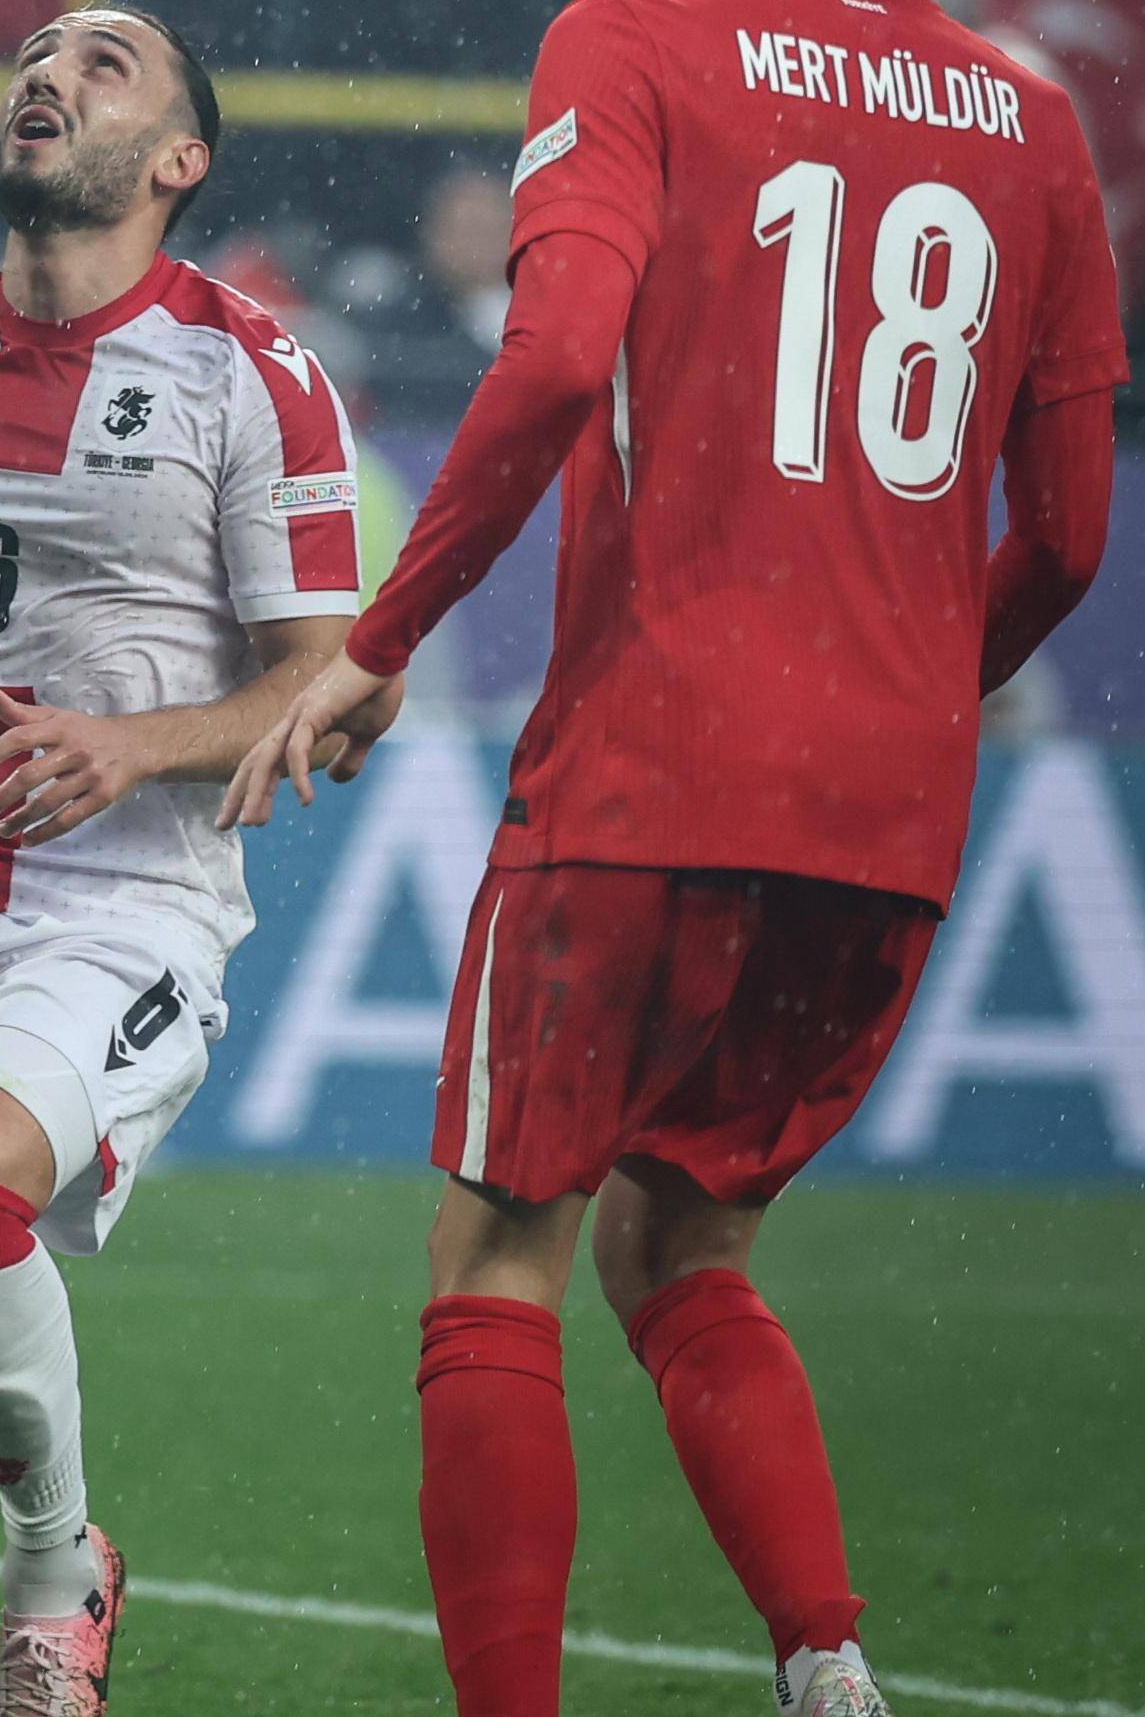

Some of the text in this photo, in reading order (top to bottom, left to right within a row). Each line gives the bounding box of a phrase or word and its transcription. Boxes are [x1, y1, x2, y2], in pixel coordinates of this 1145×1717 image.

[736, 28, 1025, 144] MERT MÜLDÜR
[754, 159, 998, 501] 18
[122, 965, 181, 1051] 6
